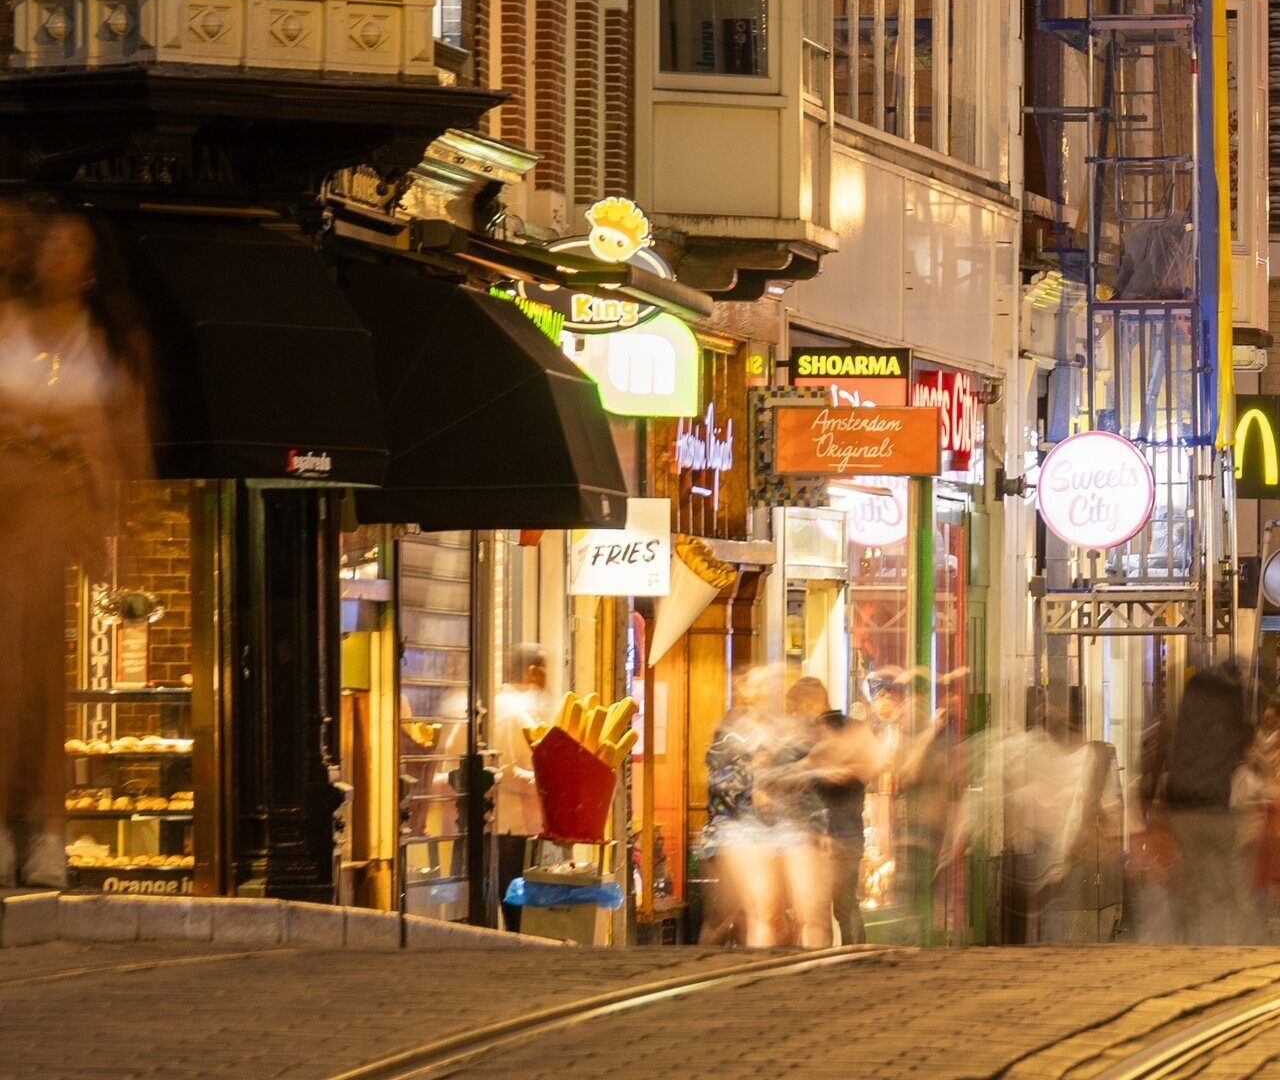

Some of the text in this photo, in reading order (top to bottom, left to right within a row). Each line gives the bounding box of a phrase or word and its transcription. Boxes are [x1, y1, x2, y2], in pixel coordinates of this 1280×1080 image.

[570, 293, 641, 328] King
[798, 354, 902, 376] SHOARMA
[811, 408, 903, 433] Amsterdam
[812, 432, 895, 474] Originals
[1050, 459, 1138, 493] Sweets
[1069, 492, 1123, 533] City
[591, 538, 661, 567] FRIES
